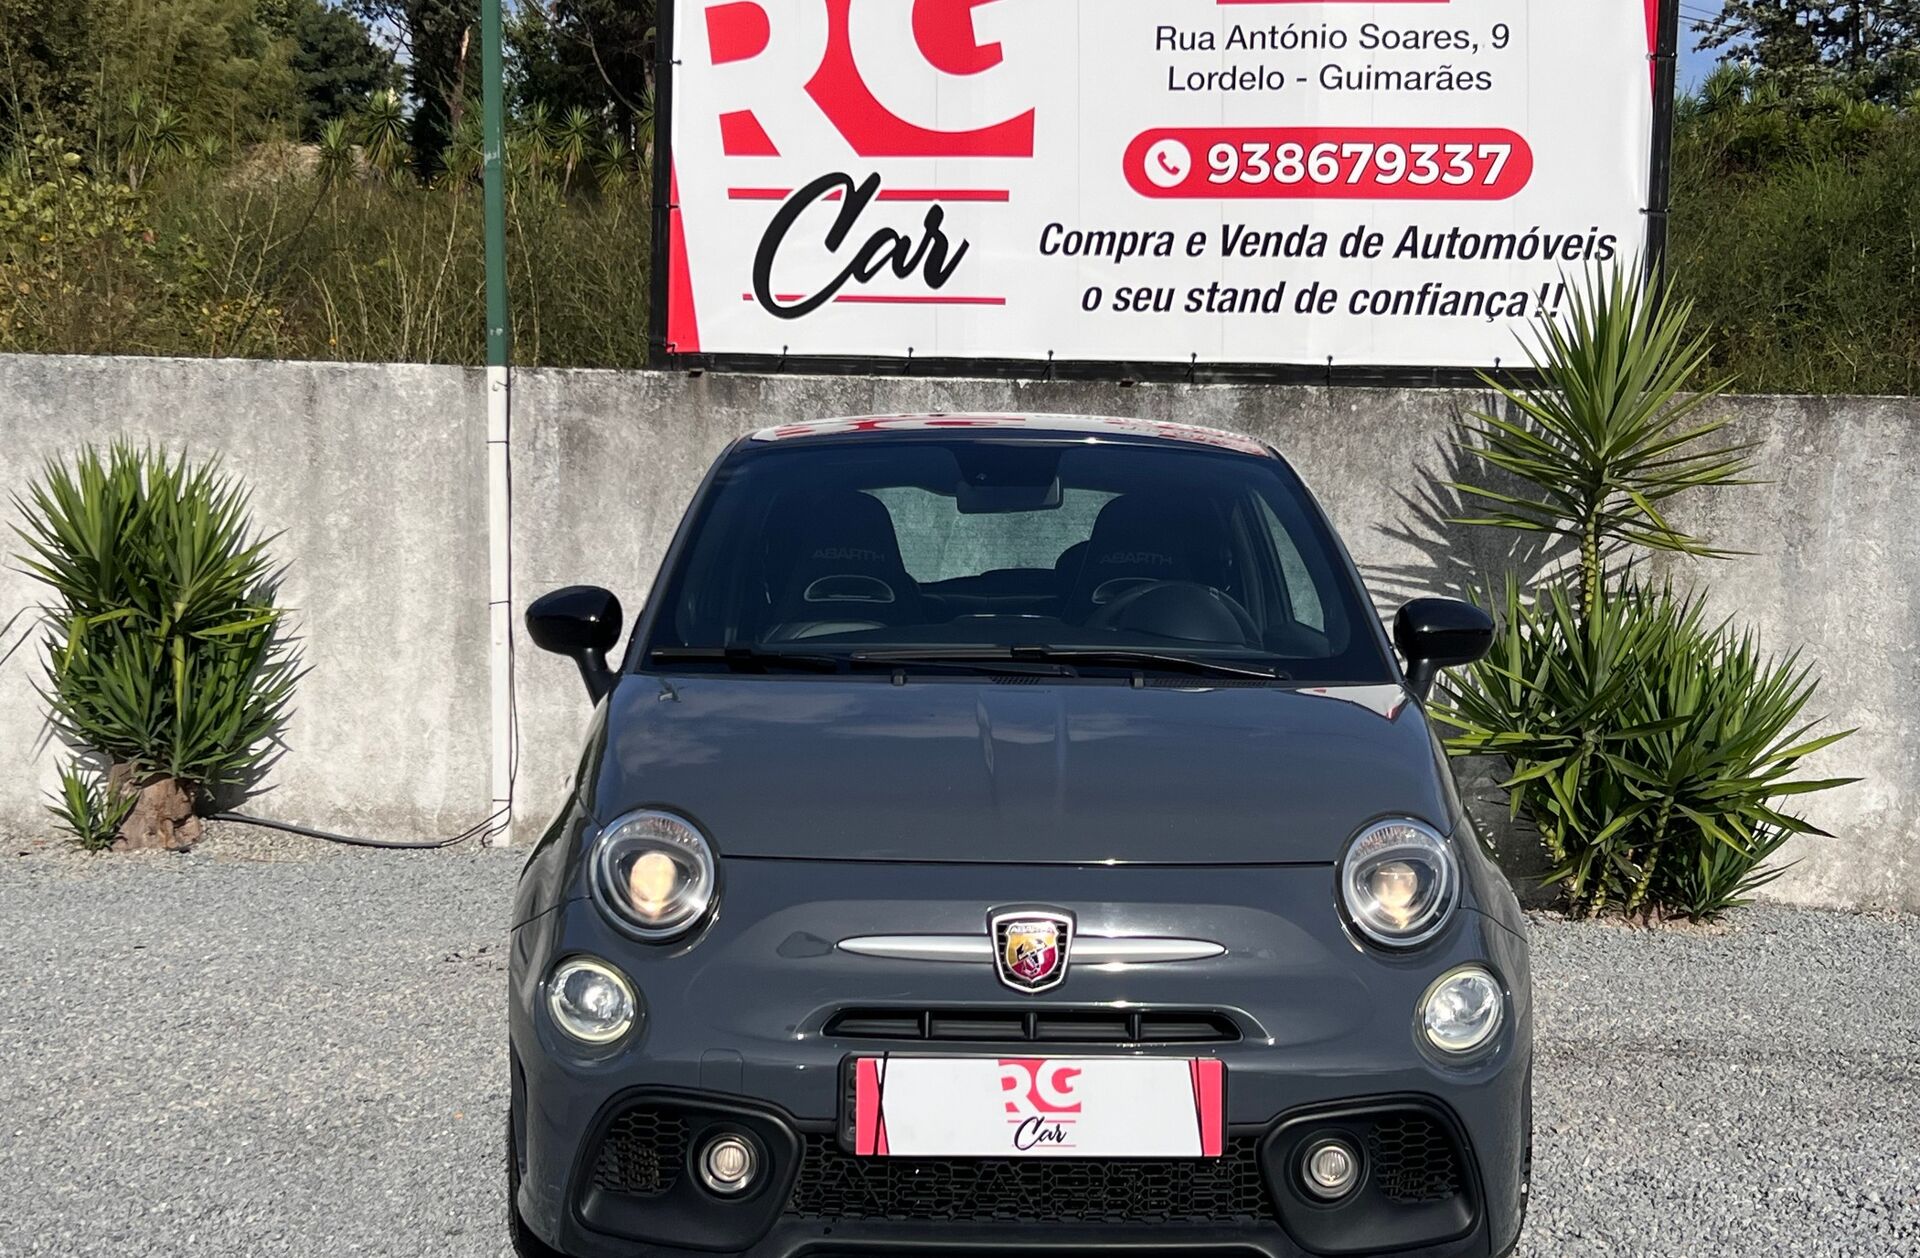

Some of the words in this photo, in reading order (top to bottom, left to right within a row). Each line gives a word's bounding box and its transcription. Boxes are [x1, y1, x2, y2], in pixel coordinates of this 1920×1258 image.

[1155, 25, 1216, 51] Rua
[1224, 23, 1348, 50] António
[1359, 23, 1478, 55] Soares,
[1491, 23, 1510, 49] 9
[702, 0, 1036, 157] RG
[1168, 64, 1285, 91] Lordelo
[1319, 63, 1492, 91] Guimarães
[1207, 142, 1512, 186] 938679337
[752, 171, 970, 319] Car
[1039, 222, 1175, 264] Compra
[1185, 231, 1207, 257] e
[1221, 224, 1328, 258] Venda
[1339, 225, 1384, 259] de
[1393, 225, 1617, 261] Automóveis
[1081, 286, 1103, 312] o
[1112, 287, 1176, 313] seu
[1184, 281, 1287, 314] stand
[1294, 282, 1338, 315] de
[999, 1059, 1081, 1112] RG
[1014, 1116, 1067, 1151] Car
